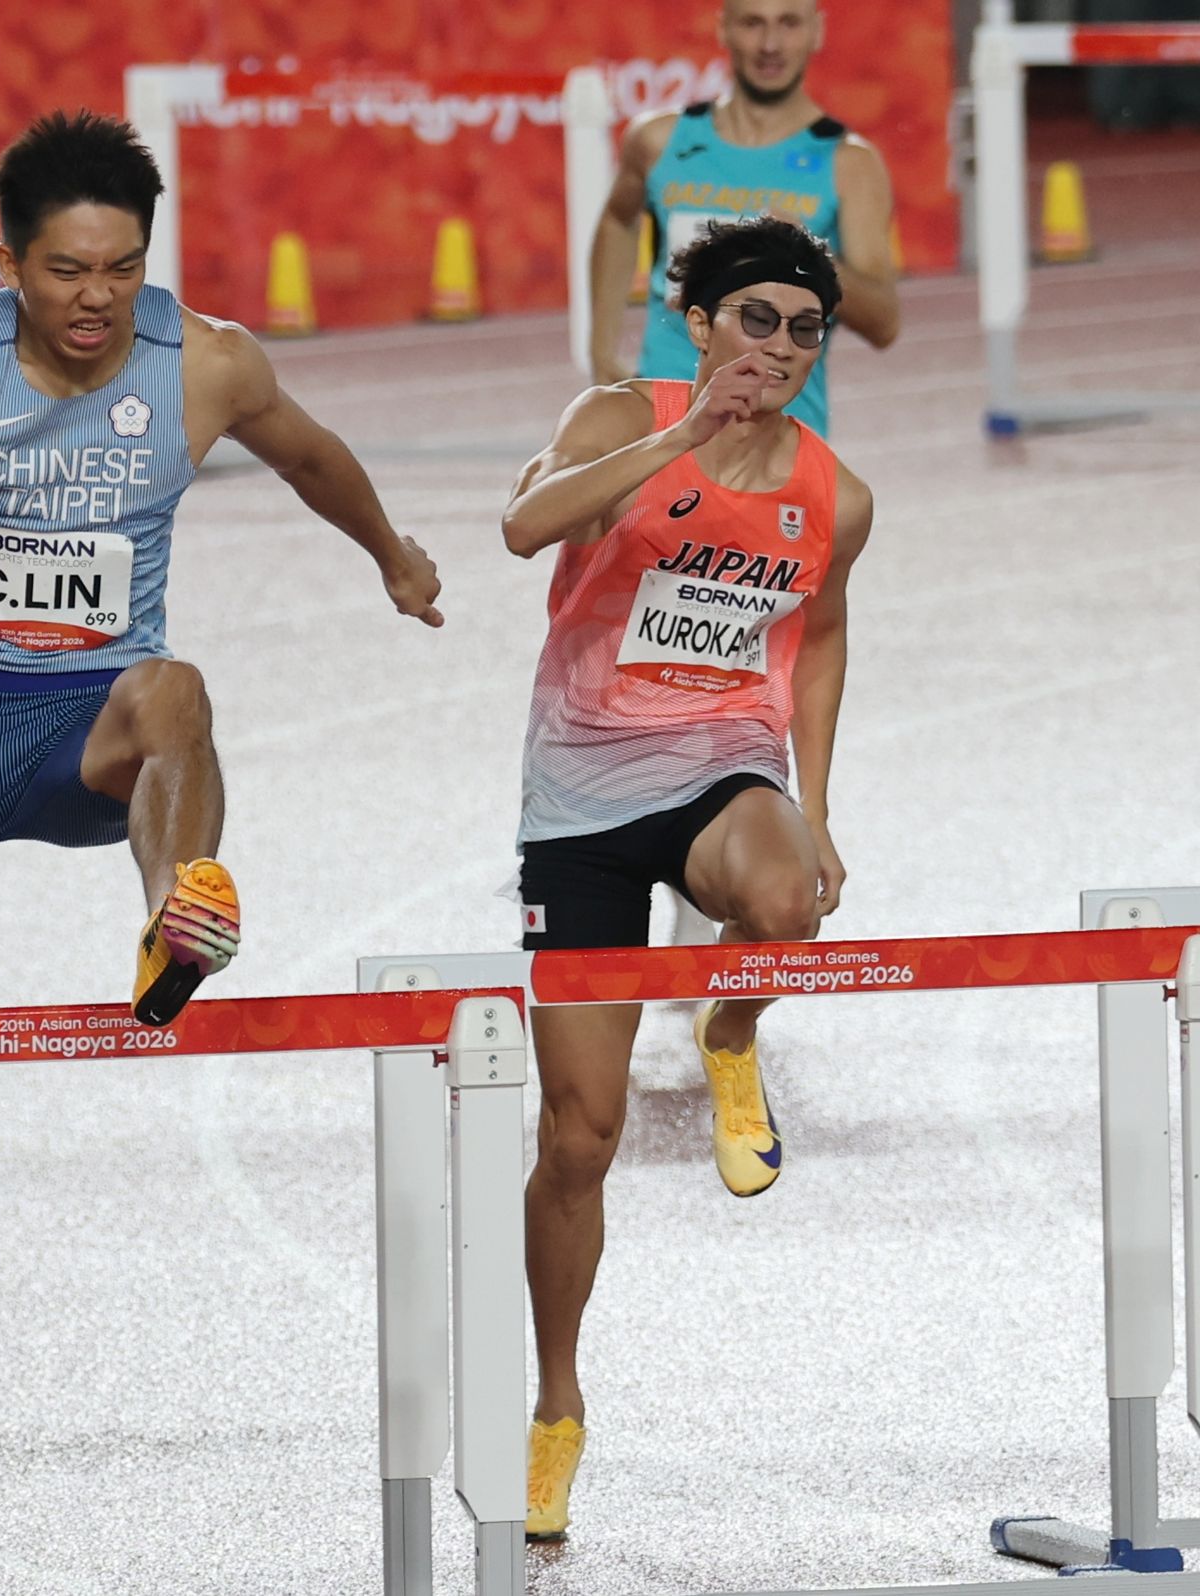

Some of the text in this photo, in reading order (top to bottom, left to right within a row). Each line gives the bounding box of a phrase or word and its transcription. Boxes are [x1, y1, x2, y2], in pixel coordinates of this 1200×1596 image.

[2, 485, 123, 524] TAIPEI
[26, 556, 95, 568] TECHNOLOGY
[656, 540, 803, 593] JAPAN
[676, 583, 777, 614] BORNAN
[84, 612, 118, 626] 699
[17, 630, 36, 638] Asian
[62, 637, 86, 646] 2026
[740, 951, 880, 968] 20th Asian Games
[707, 965, 914, 992] Aichi-Nagoya 2026
[39, 1016, 82, 1031] Asian
[86, 1015, 142, 1029] Games
[121, 1030, 177, 1050] 2026
